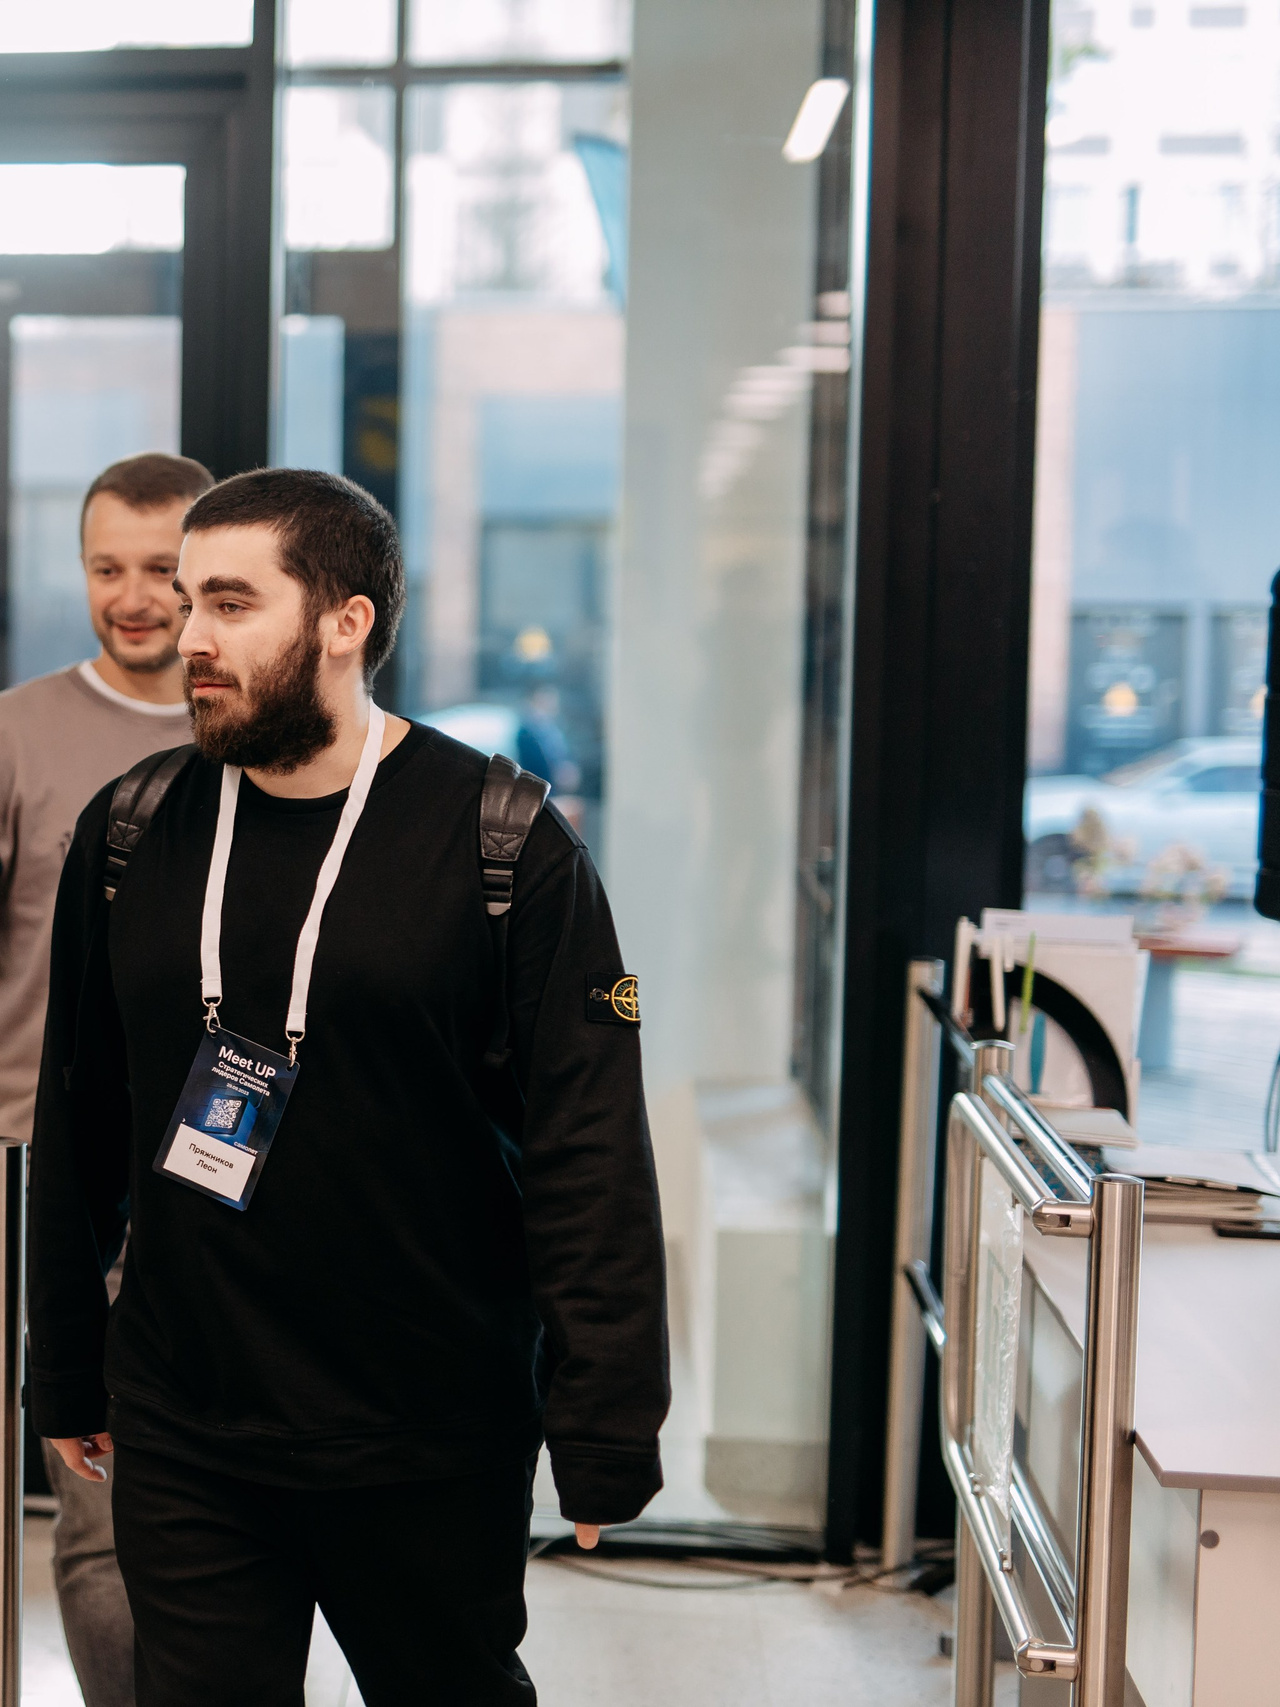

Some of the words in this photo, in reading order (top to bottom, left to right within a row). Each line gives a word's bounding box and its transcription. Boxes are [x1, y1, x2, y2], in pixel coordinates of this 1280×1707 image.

[218, 1045, 254, 1071] Meet
[255, 1062, 276, 1078] UP
[218, 1061, 269, 1088] Стратегических
[211, 1066, 239, 1082] лидеров
[239, 1077, 271, 1096] Самолета
[188, 1142, 234, 1169] Пряжников
[196, 1159, 218, 1174] Леон
